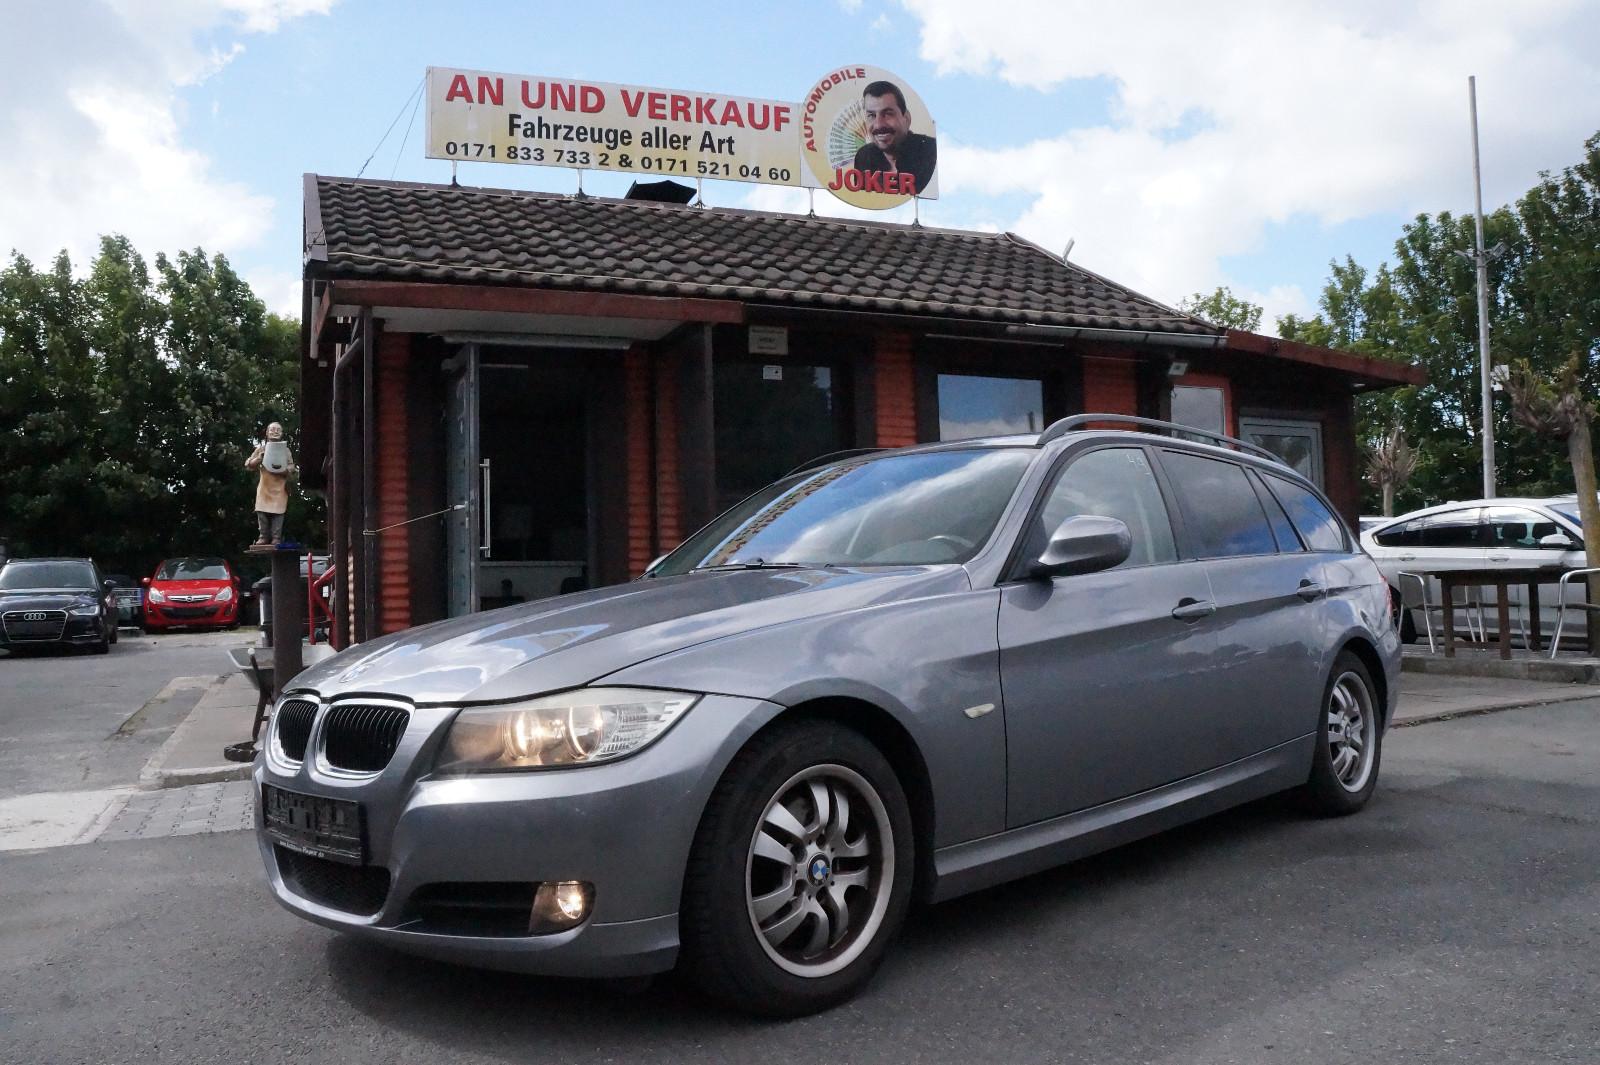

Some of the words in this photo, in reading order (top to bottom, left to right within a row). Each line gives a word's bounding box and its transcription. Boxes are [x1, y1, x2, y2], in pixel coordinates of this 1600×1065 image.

[445, 74, 504, 105] AN
[521, 80, 605, 114] UND
[620, 89, 791, 132] VERKAUF
[804, 68, 865, 152] AUTOMOBILE
[508, 114, 632, 150] Fahrzeuge
[641, 128, 691, 150] aller
[699, 131, 735, 156] Art
[445, 141, 496, 158] 0171
[506, 145, 545, 161] 833
[553, 149, 591, 165] 733
[598, 152, 610, 166] 2
[618, 153, 633, 168] &
[641, 157, 688, 173] 0171
[697, 160, 731, 177] 521
[739, 165, 761, 179] 04
[768, 167, 791, 182] 60
[828, 167, 917, 196] JOKER
